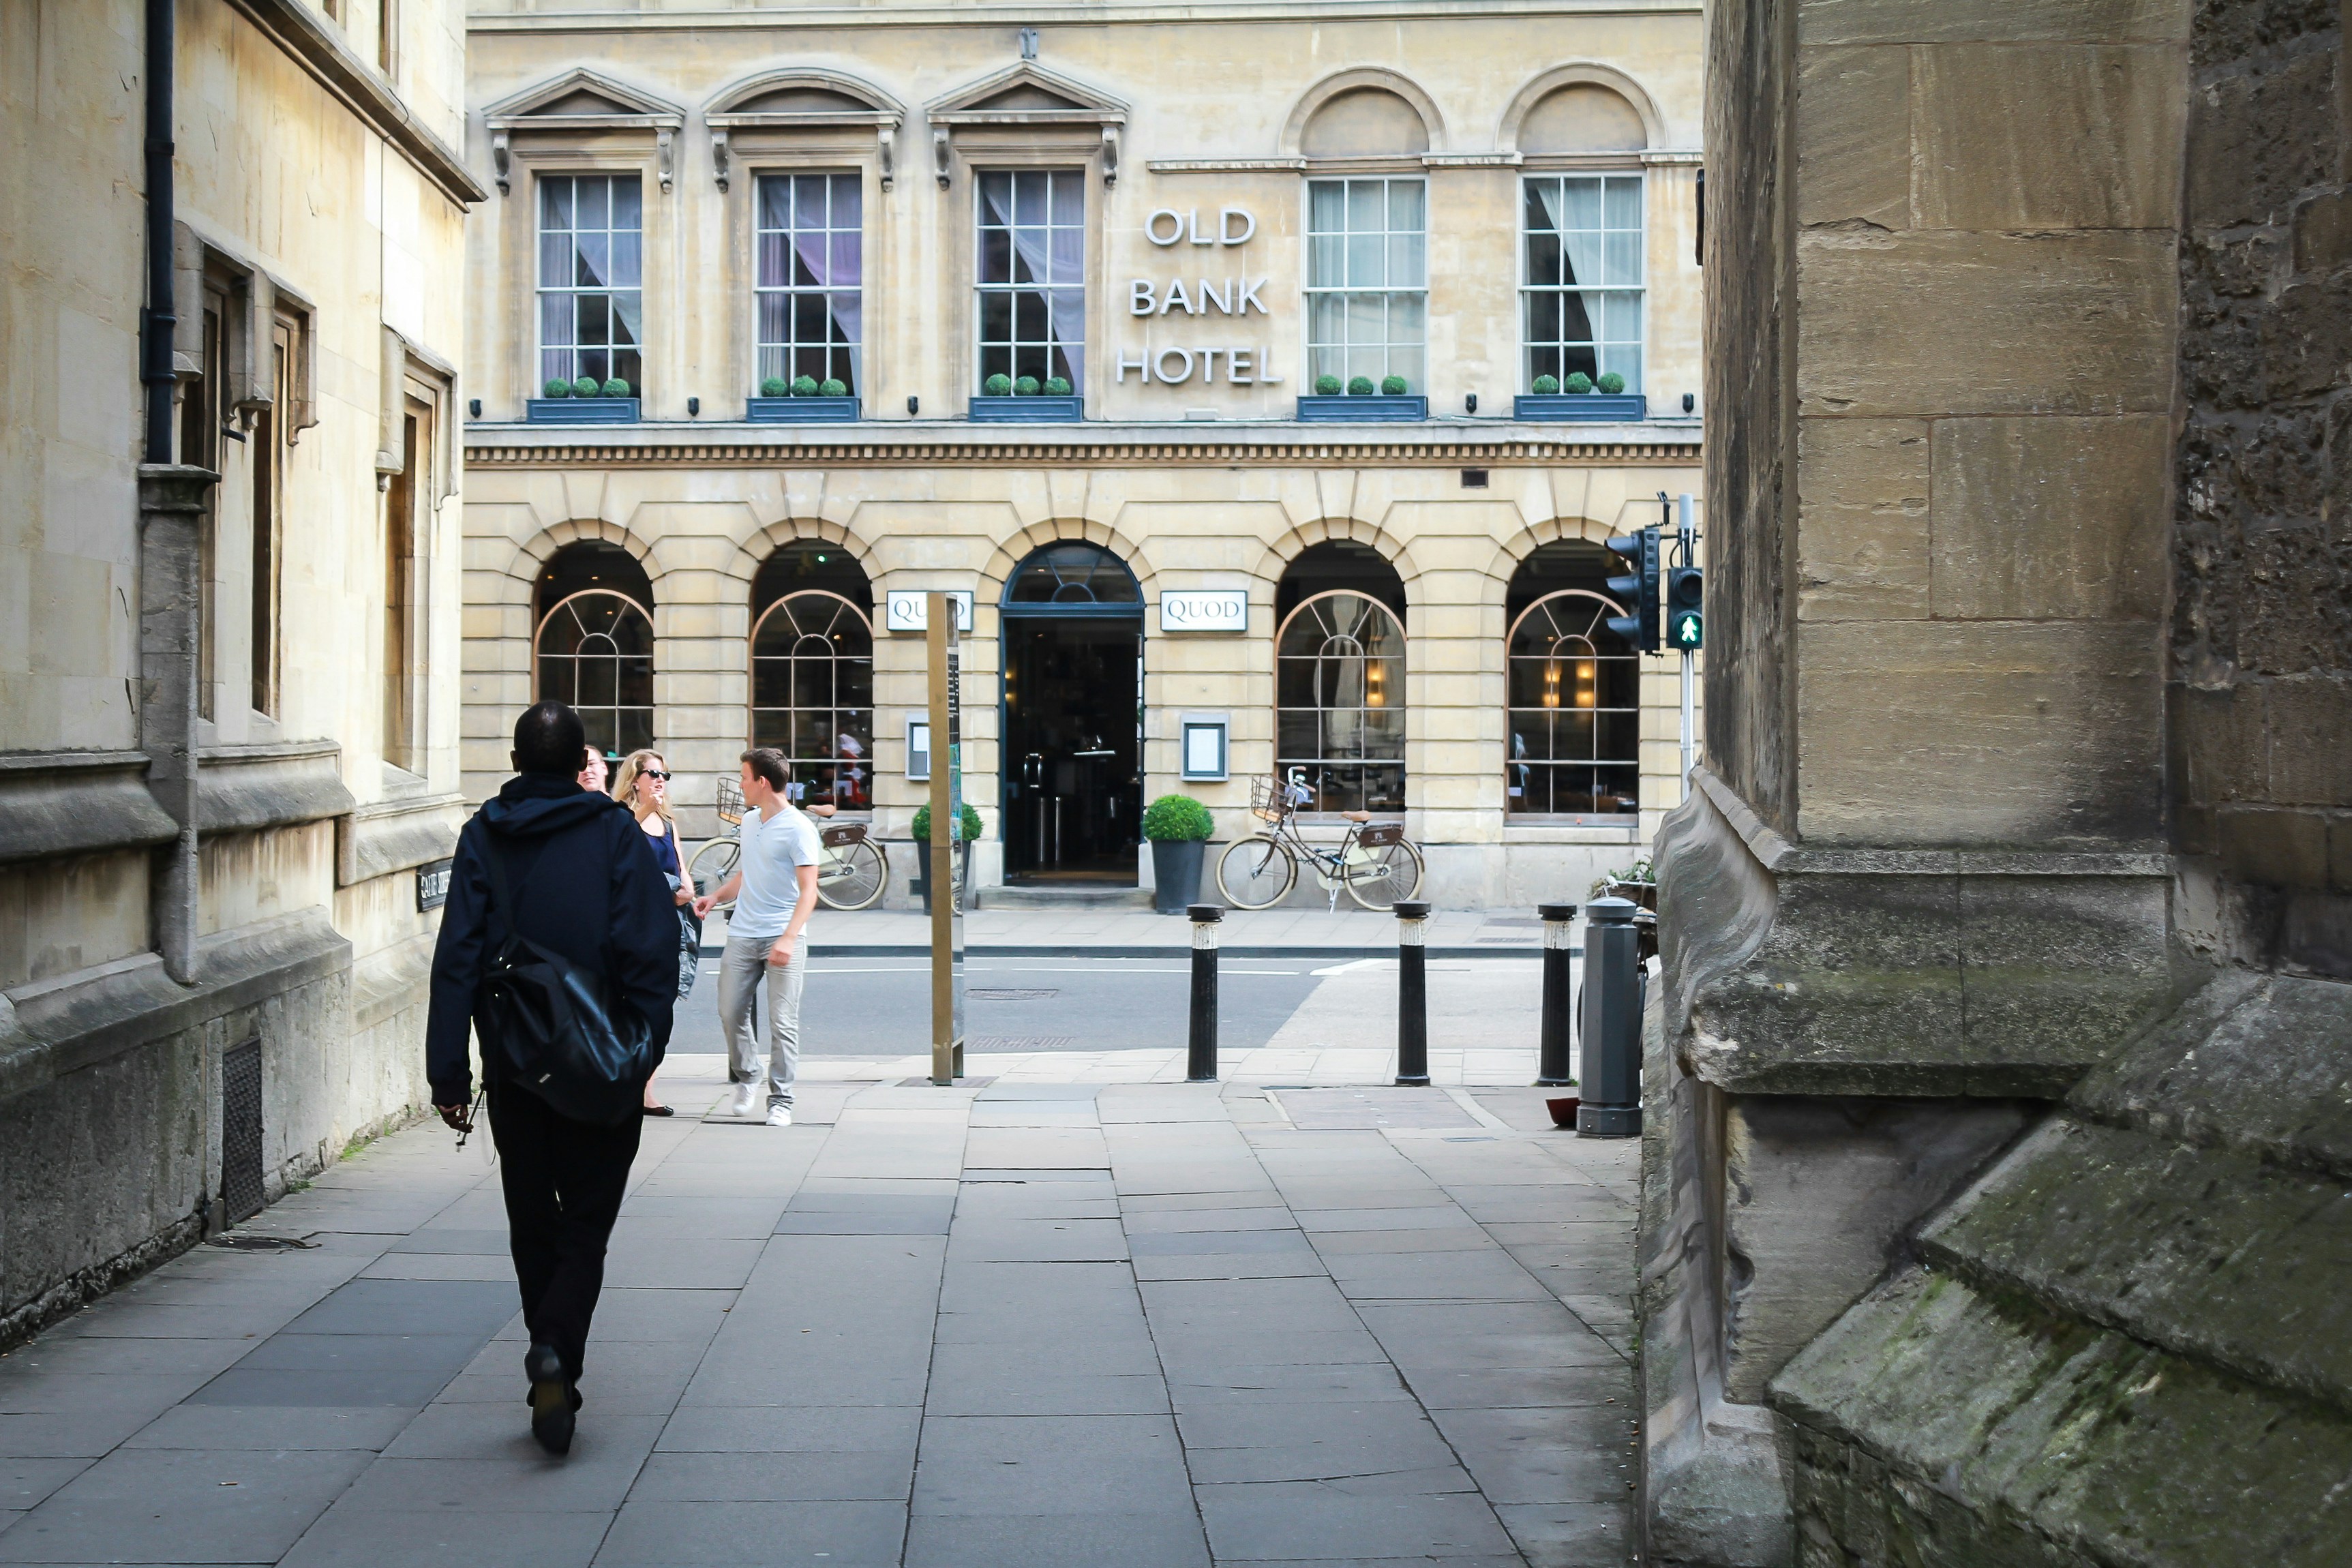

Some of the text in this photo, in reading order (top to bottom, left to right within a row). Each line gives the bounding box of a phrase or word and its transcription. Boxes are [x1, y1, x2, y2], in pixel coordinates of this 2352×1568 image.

[1145, 208, 1256, 245] OLD
[1130, 278, 1269, 316] BANK
[1116, 346, 1284, 384] HOTEL
[894, 599, 965, 622] QU
[1168, 599, 1239, 623] QUOD
